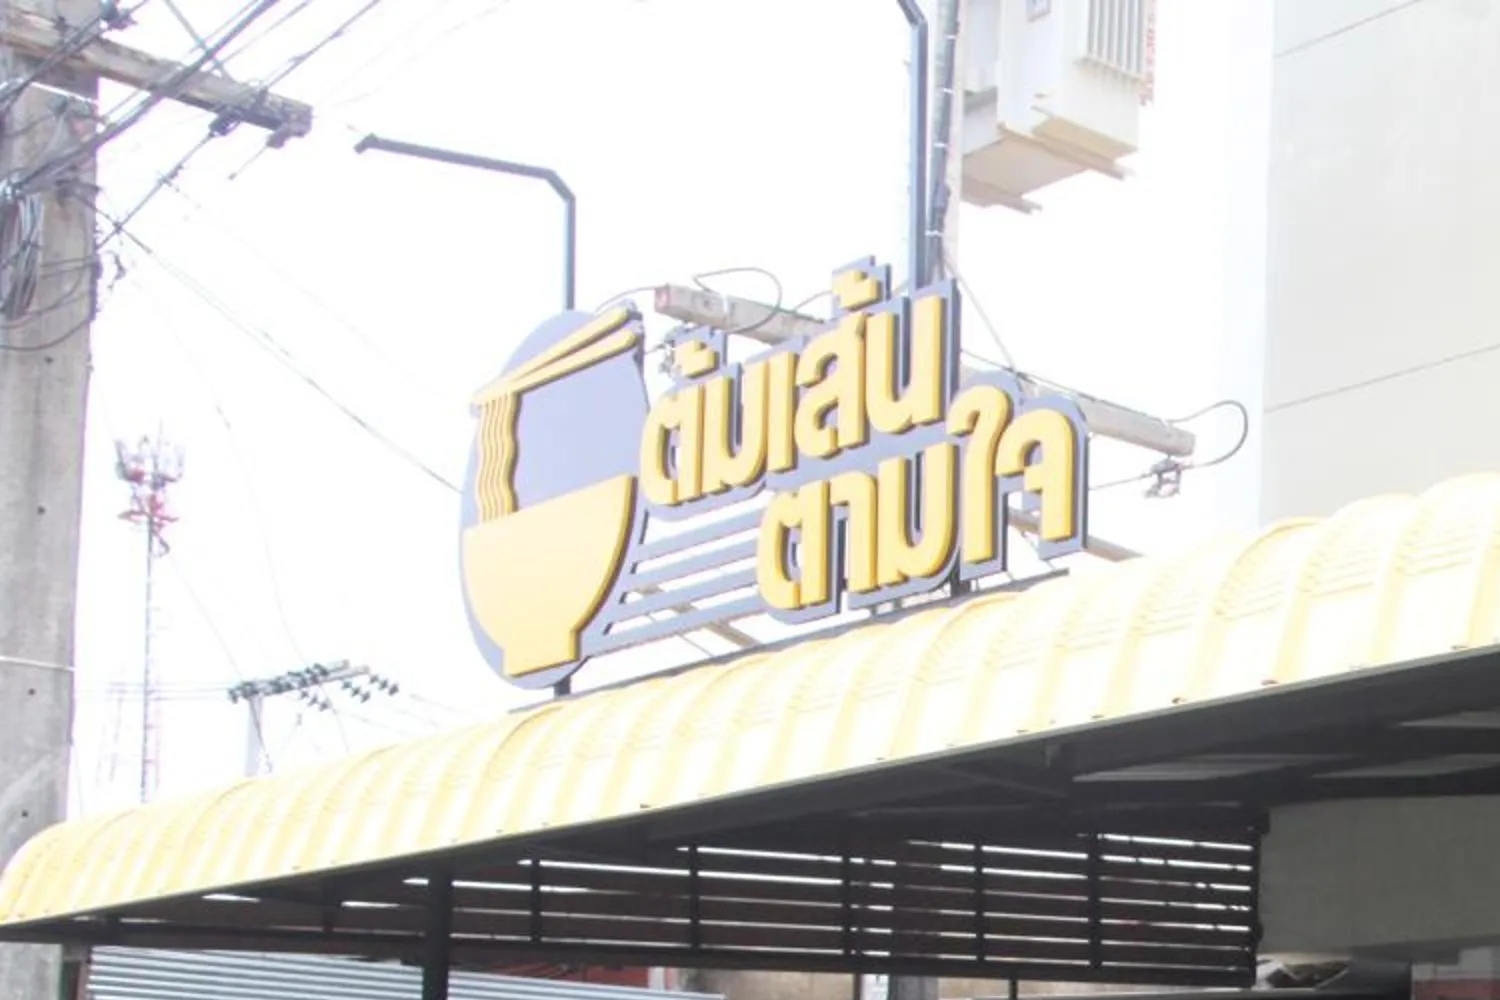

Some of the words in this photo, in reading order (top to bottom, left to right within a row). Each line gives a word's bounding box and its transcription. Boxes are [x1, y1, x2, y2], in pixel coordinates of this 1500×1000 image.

[640, 268, 949, 507] ต้มเส้น
[757, 384, 1076, 609] ตามใจ
